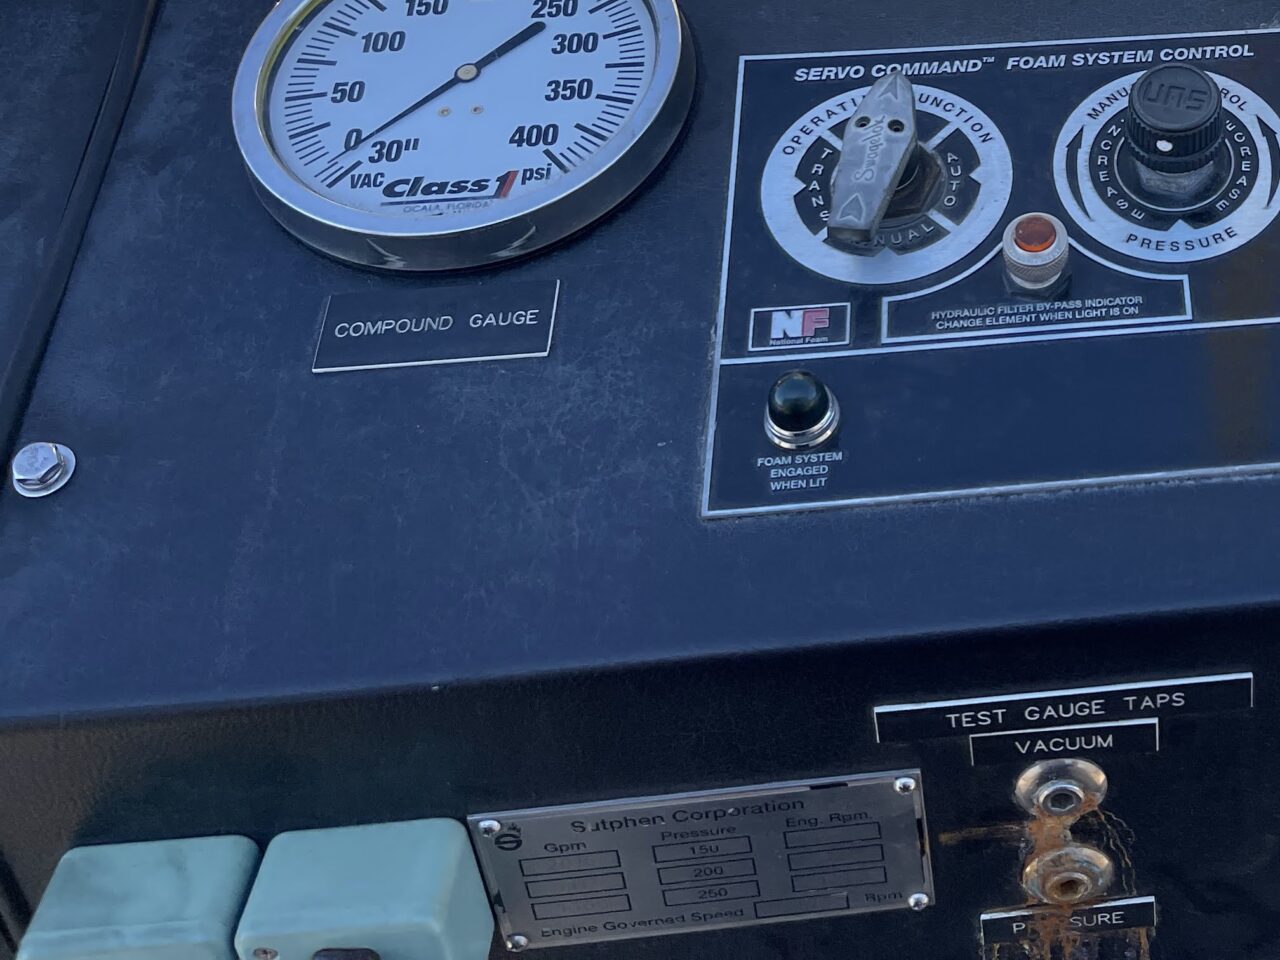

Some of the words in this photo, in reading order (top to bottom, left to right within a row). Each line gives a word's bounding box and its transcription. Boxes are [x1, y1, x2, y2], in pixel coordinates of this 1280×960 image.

[362, 30, 406, 53] 100
[551, 32, 599, 54] 300
[794, 65, 865, 82] SERVO
[1006, 55, 1065, 70] FOAM
[1072, 49, 1154, 66] SYSTEM
[1160, 44, 1255, 61] CONTROL
[331, 81, 365, 103] 50
[545, 79, 594, 101] 350
[509, 123, 559, 147] 400
[350, 172, 385, 189] VAC
[521, 164, 552, 186] psi
[1126, 227, 1238, 252] PRESSURE
[931, 307, 995, 320] HYDRAULIC
[998, 304, 1033, 315] FILTER
[1036, 300, 1082, 312] BY-PASS
[1085, 296, 1143, 307] INDICATOR
[936, 318, 983, 330] CHANGE
[985, 314, 1037, 326] ELEMENT
[1040, 311, 1073, 322] WHEN
[1075, 308, 1107, 319] LIGHT
[1109, 307, 1120, 316] IS
[1122, 305, 1139, 316] ON
[334, 315, 453, 338] COMPOUND
[469, 309, 540, 328] GAUGE
[757, 455, 792, 467] FOAM
[794, 451, 843, 464] SYSTEM
[770, 465, 829, 478] ENGAGED
[770, 479, 807, 491] WHEN
[809, 477, 828, 488] LIT
[946, 709, 1007, 728] TEST
[1024, 700, 1105, 721] GAUGE
[1123, 692, 1185, 711] TAPS
[1015, 734, 1113, 754] VACUUM
[672, 800, 805, 823] Corporation
[544, 841, 587, 854] Gpm
[661, 826, 737, 841] Pressure
